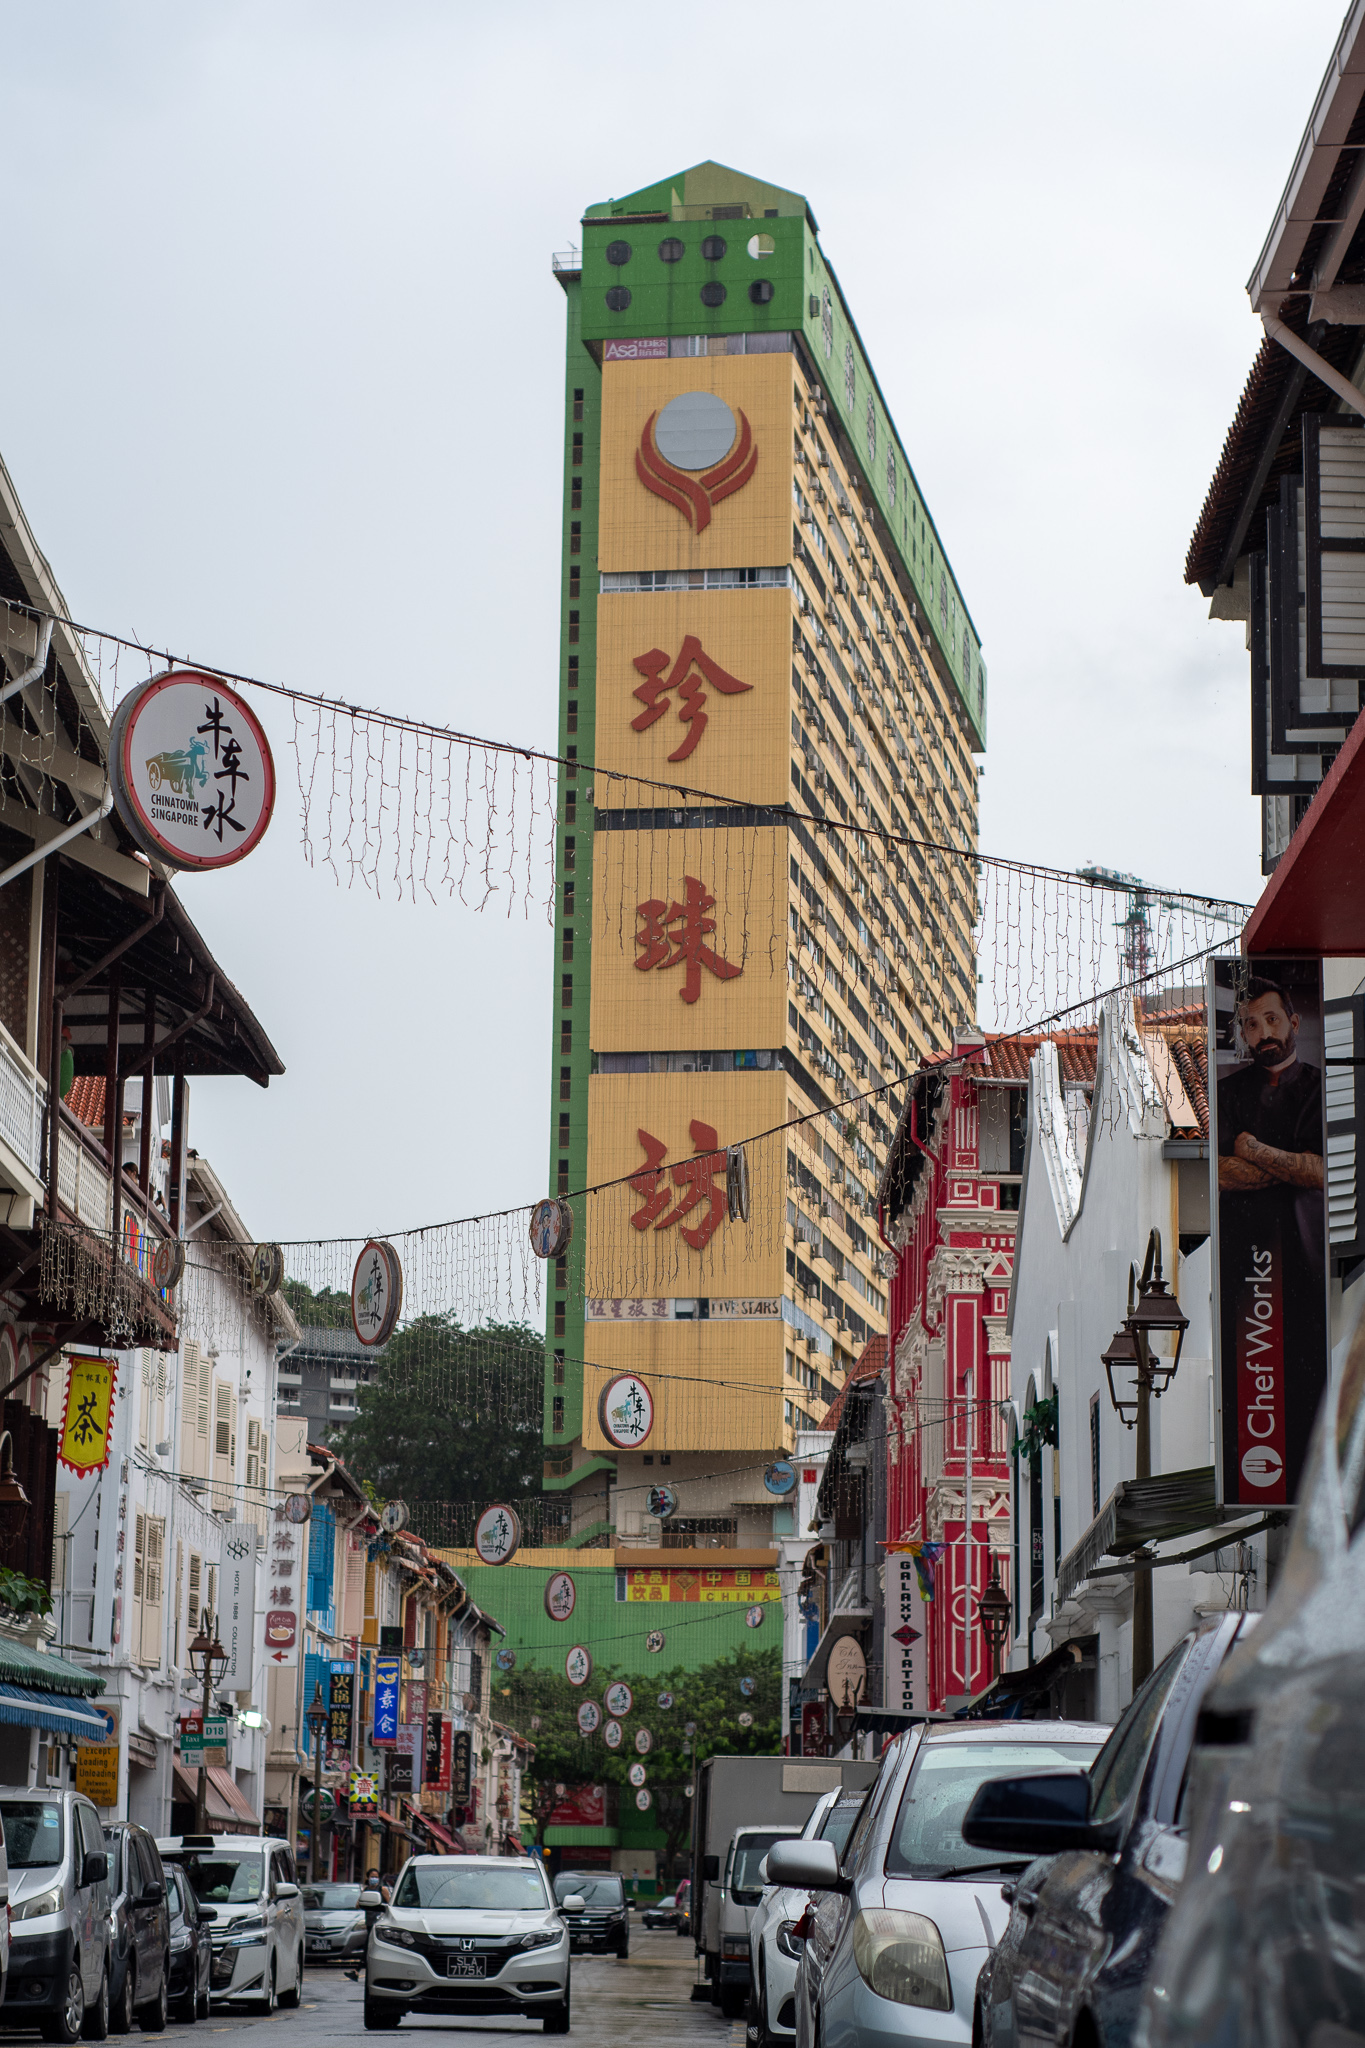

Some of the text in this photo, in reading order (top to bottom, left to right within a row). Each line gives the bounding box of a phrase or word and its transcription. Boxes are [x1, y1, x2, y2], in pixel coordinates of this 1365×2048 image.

[606, 342, 638, 358] Asa
[151, 793, 199, 813] CHINATOWN
[151, 808, 199, 827] SINGAPORE
[630, 634, 754, 1251] 珍珠坊
[711, 1300, 779, 1315] FIVE STARS
[1246, 1362, 1275, 1438] Chef
[68, 1391, 104, 1446] 茶
[633, 1570, 664, 1584] 食品
[706, 1592, 771, 1602] CHINA
[900, 1561, 914, 1710] GALAXY TATTOO
[230, 1625, 238, 1677] COLLECTION
[839, 1646, 858, 1657] The
[333, 1675, 350, 1704] 火锅
[206, 1727, 224, 1735] D18
[185, 1735, 200, 1743] Taxi
[85, 1748, 111, 1756] Except
[183, 1753, 189, 1764] 1
[79, 1757, 108, 1768] Loading
[79, 1768, 116, 1779] Unloading
[457, 1957, 477, 1966] SLA
[450, 1966, 483, 1975] 7175K
